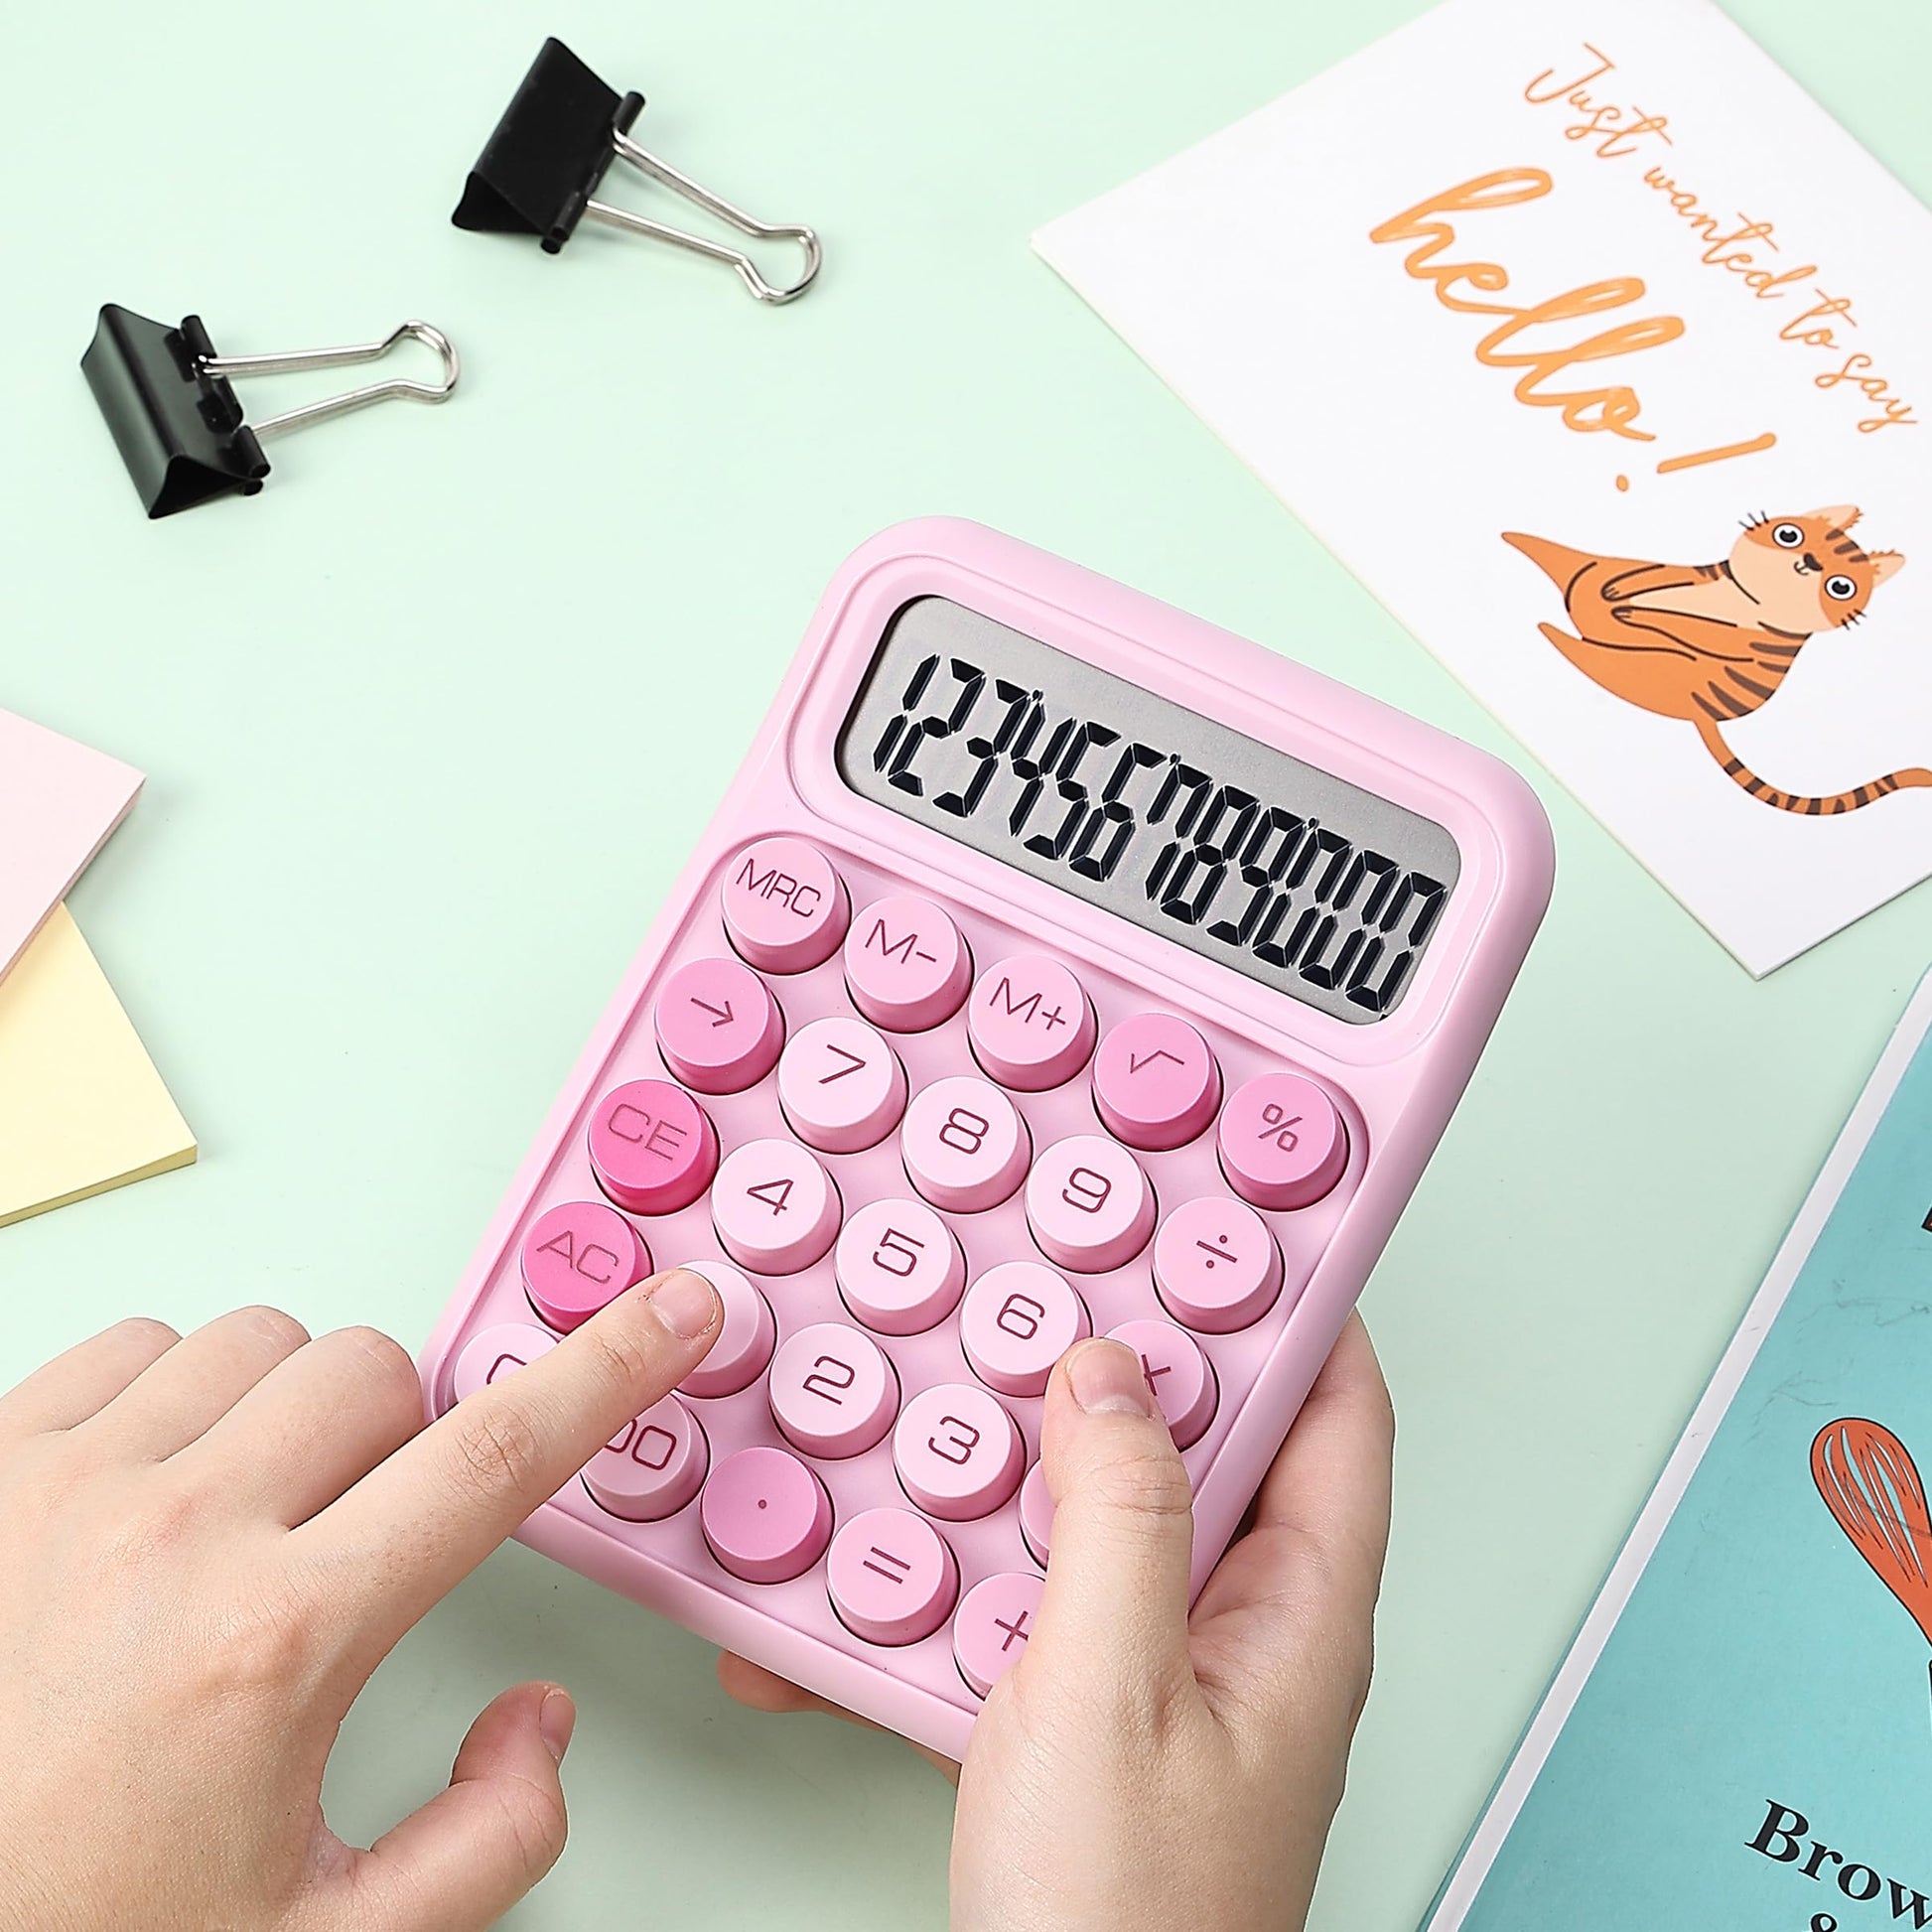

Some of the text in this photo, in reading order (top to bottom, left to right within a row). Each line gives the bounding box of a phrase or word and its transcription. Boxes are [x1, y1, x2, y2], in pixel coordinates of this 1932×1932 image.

[1525, 42, 1918, 433] Just wanted to say
[735, 858, 822, 918] MRC
[865, 918, 937, 964] M-
[989, 977, 1066, 1032] M+
[818, 1043, 867, 1085] 7
[608, 1103, 688, 1162] CE
[939, 1107, 990, 1156] 8
[1258, 1103, 1304, 1153] %
[747, 1177, 795, 1217] 4
[1062, 1167, 1112, 1214] 9
[536, 1230, 620, 1285] AC
[872, 1227, 925, 1278] 5
[996, 1293, 1046, 1341] 6
[802, 1355, 856, 1406] 2
[928, 1415, 981, 1465] 3
[1743, 1798, 1932, 1931] Brow
